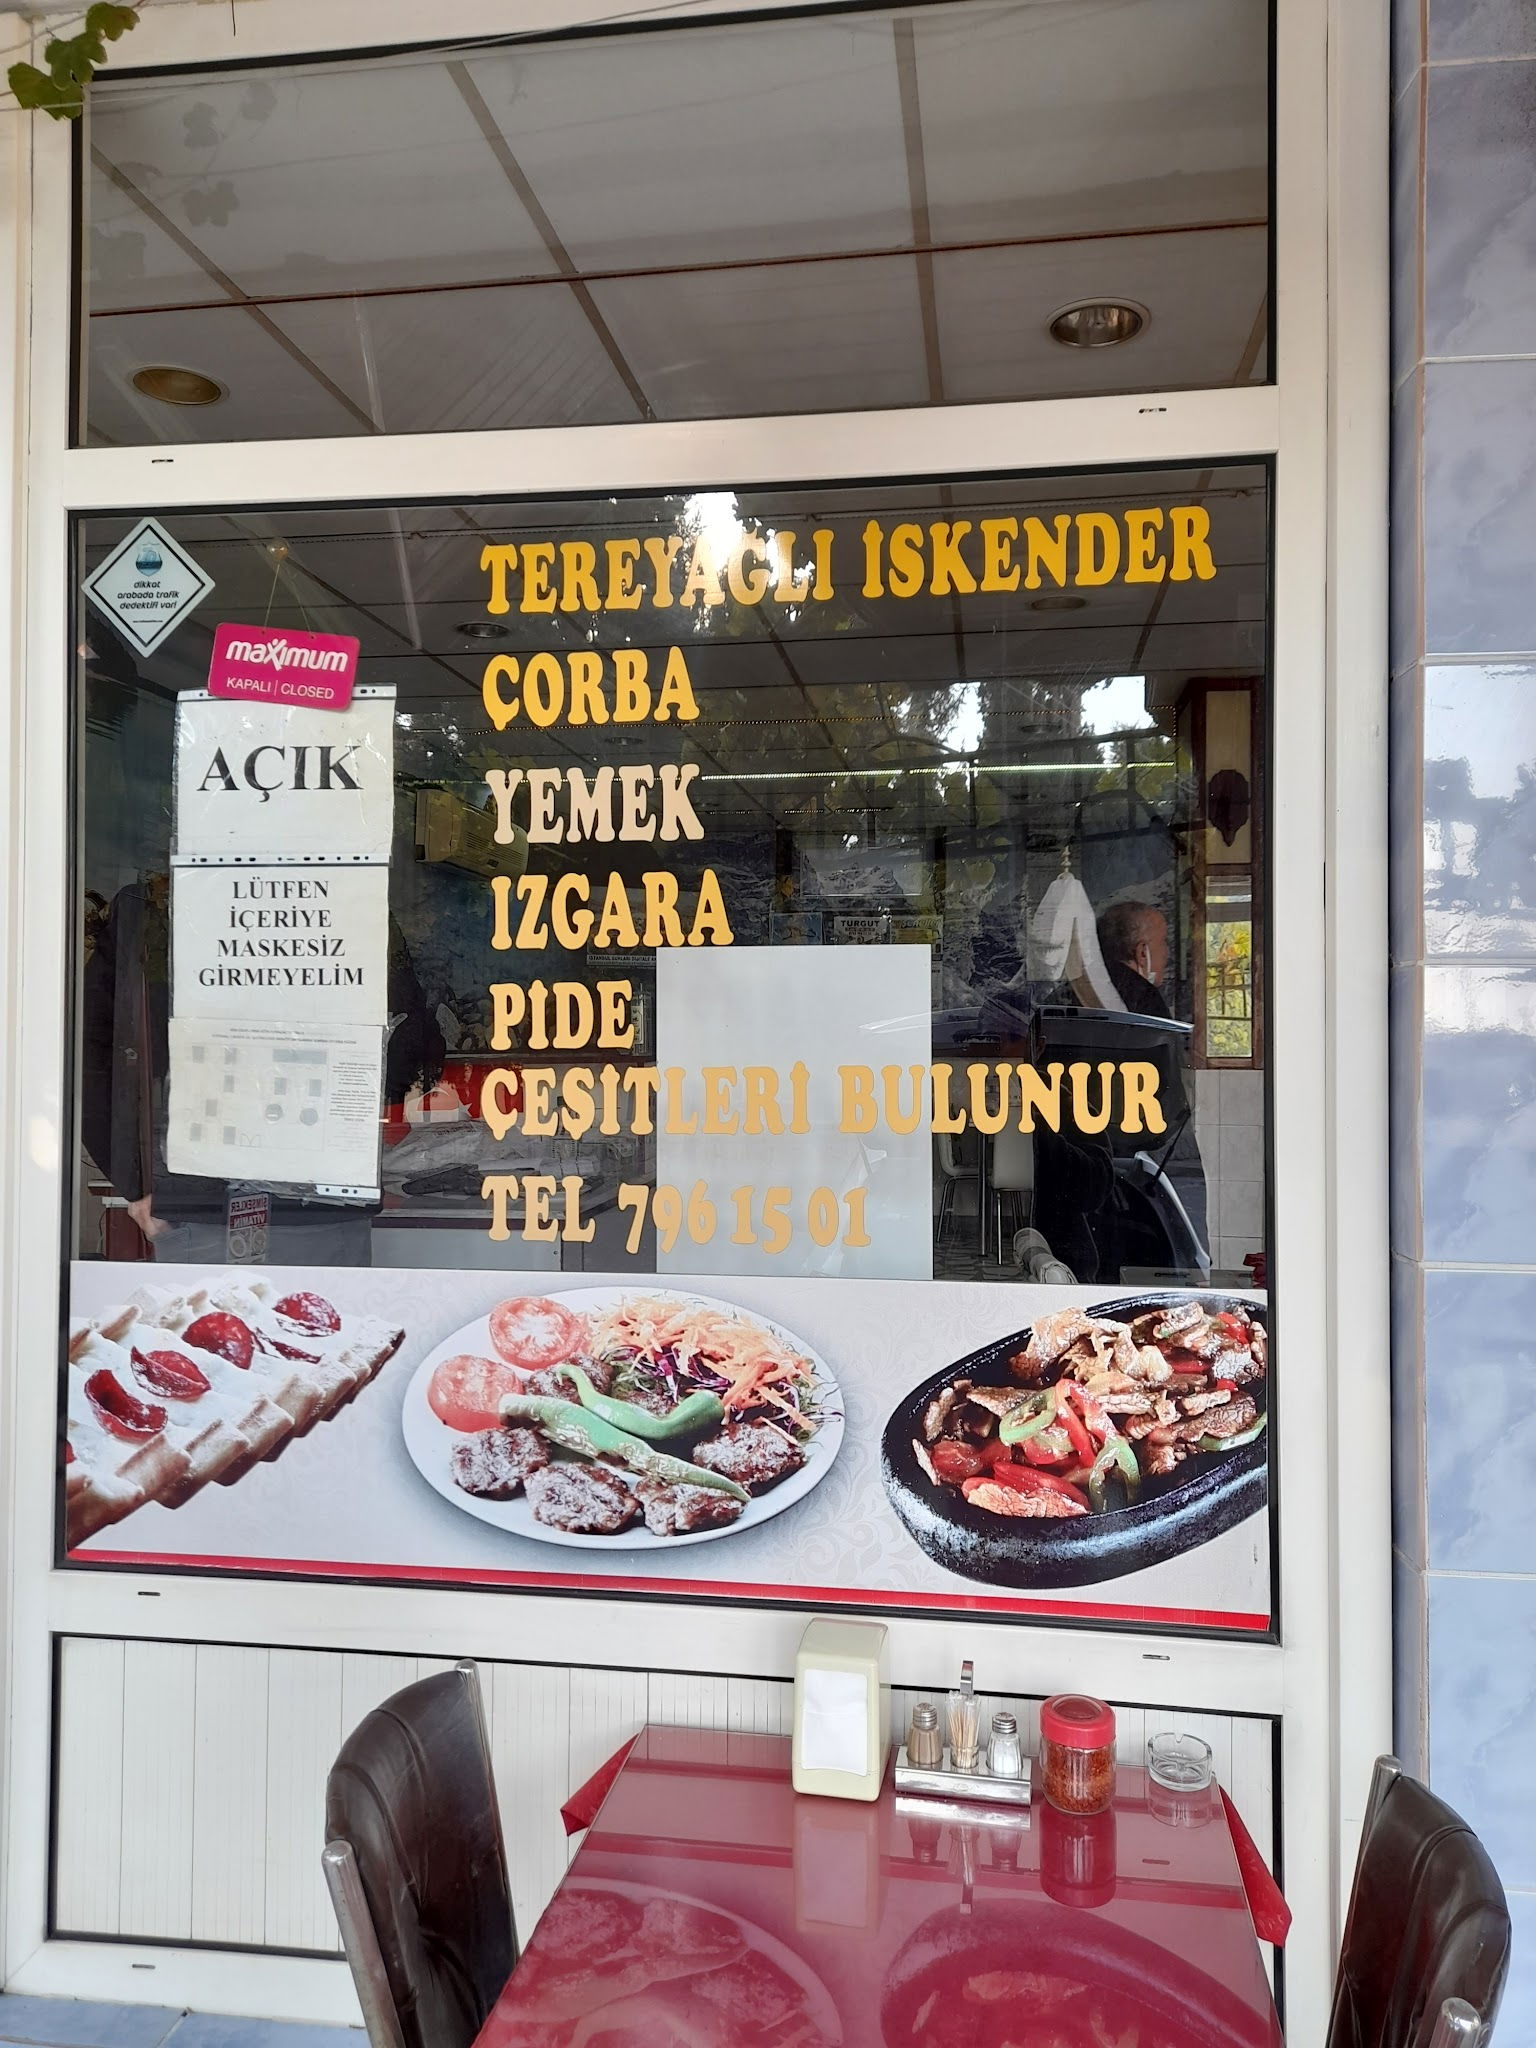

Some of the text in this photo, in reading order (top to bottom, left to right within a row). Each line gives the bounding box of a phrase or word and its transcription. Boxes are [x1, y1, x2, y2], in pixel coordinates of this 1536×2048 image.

[481, 506, 1217, 615] TEREYAĞLI İSKENDER
[156, 590, 179, 599] trafik
[226, 677, 335, 699] KAPALI CLOSED
[482, 646, 700, 731] ÇORBA
[196, 745, 364, 803] AÇIK
[485, 763, 705, 845] YEMEK
[232, 876, 329, 899] LÜTFEN
[491, 868, 735, 950] IZGARA
[217, 934, 346, 957] MASKESİZ
[229, 905, 332, 932] İÇERİYE
[840, 919, 880, 928] TURGUT
[198, 963, 364, 987] GİRMEYELİM
[490, 979, 635, 1051] PİDE
[481, 1061, 1167, 1141] ÇEŞİTLERİ BULUNUR
[481, 1175, 872, 1255] TEL 796 15 01
